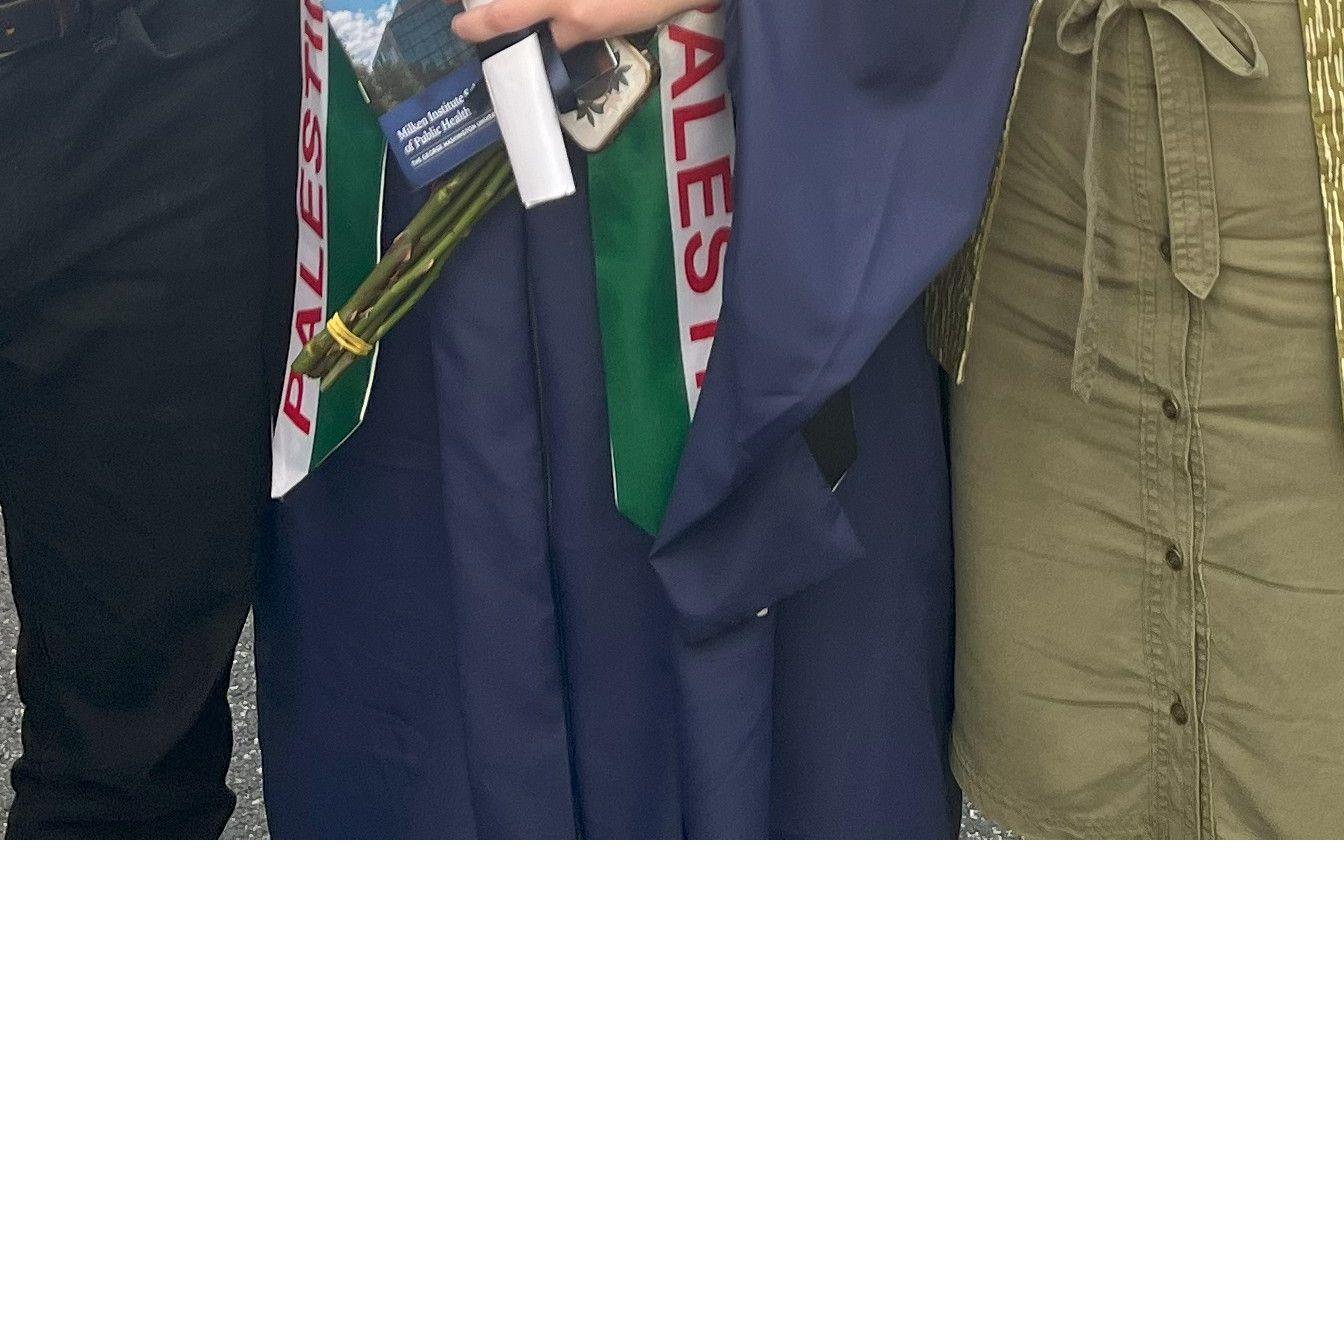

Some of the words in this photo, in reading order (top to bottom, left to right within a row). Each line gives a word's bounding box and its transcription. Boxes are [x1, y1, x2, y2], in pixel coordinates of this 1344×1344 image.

[396, 116, 429, 141] Milken
[427, 93, 465, 122] Institute
[404, 138, 415, 155] of
[413, 124, 443, 150] Public
[440, 106, 473, 131] Health
